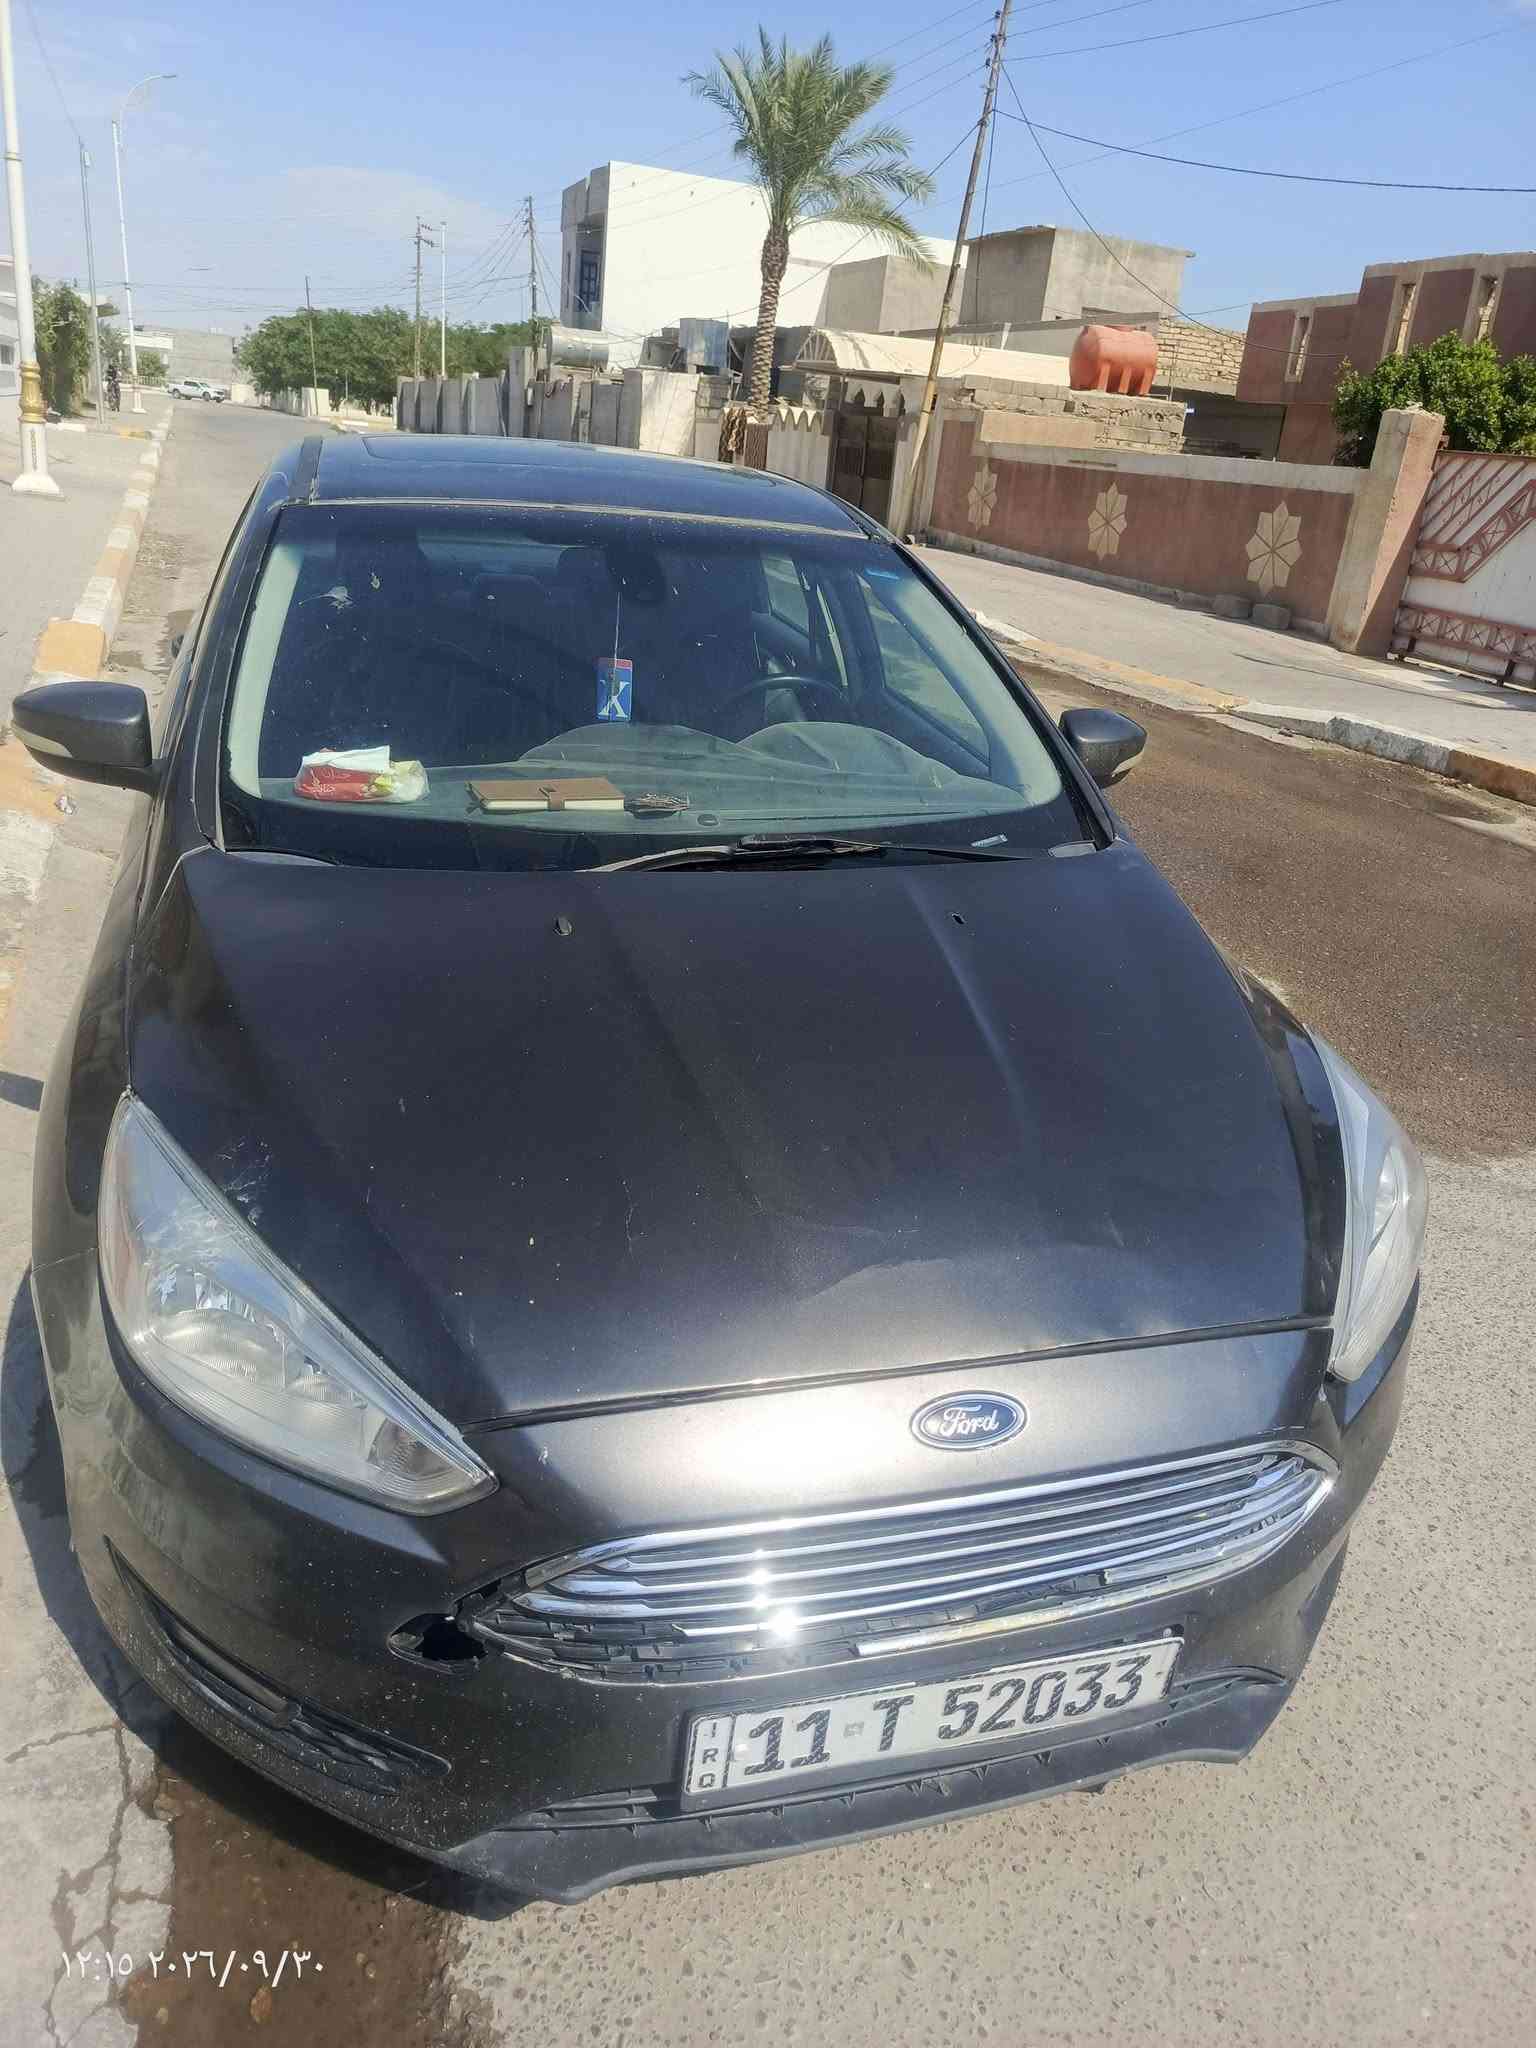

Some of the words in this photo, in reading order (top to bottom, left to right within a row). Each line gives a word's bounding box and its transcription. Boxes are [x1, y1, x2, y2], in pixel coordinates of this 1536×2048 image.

[940, 1404, 1000, 1438] Ford
[744, 1708, 831, 1775] 11
[872, 1694, 915, 1752] T
[937, 1653, 1152, 1740] 52033
[698, 1720, 719, 1788] IRQ
